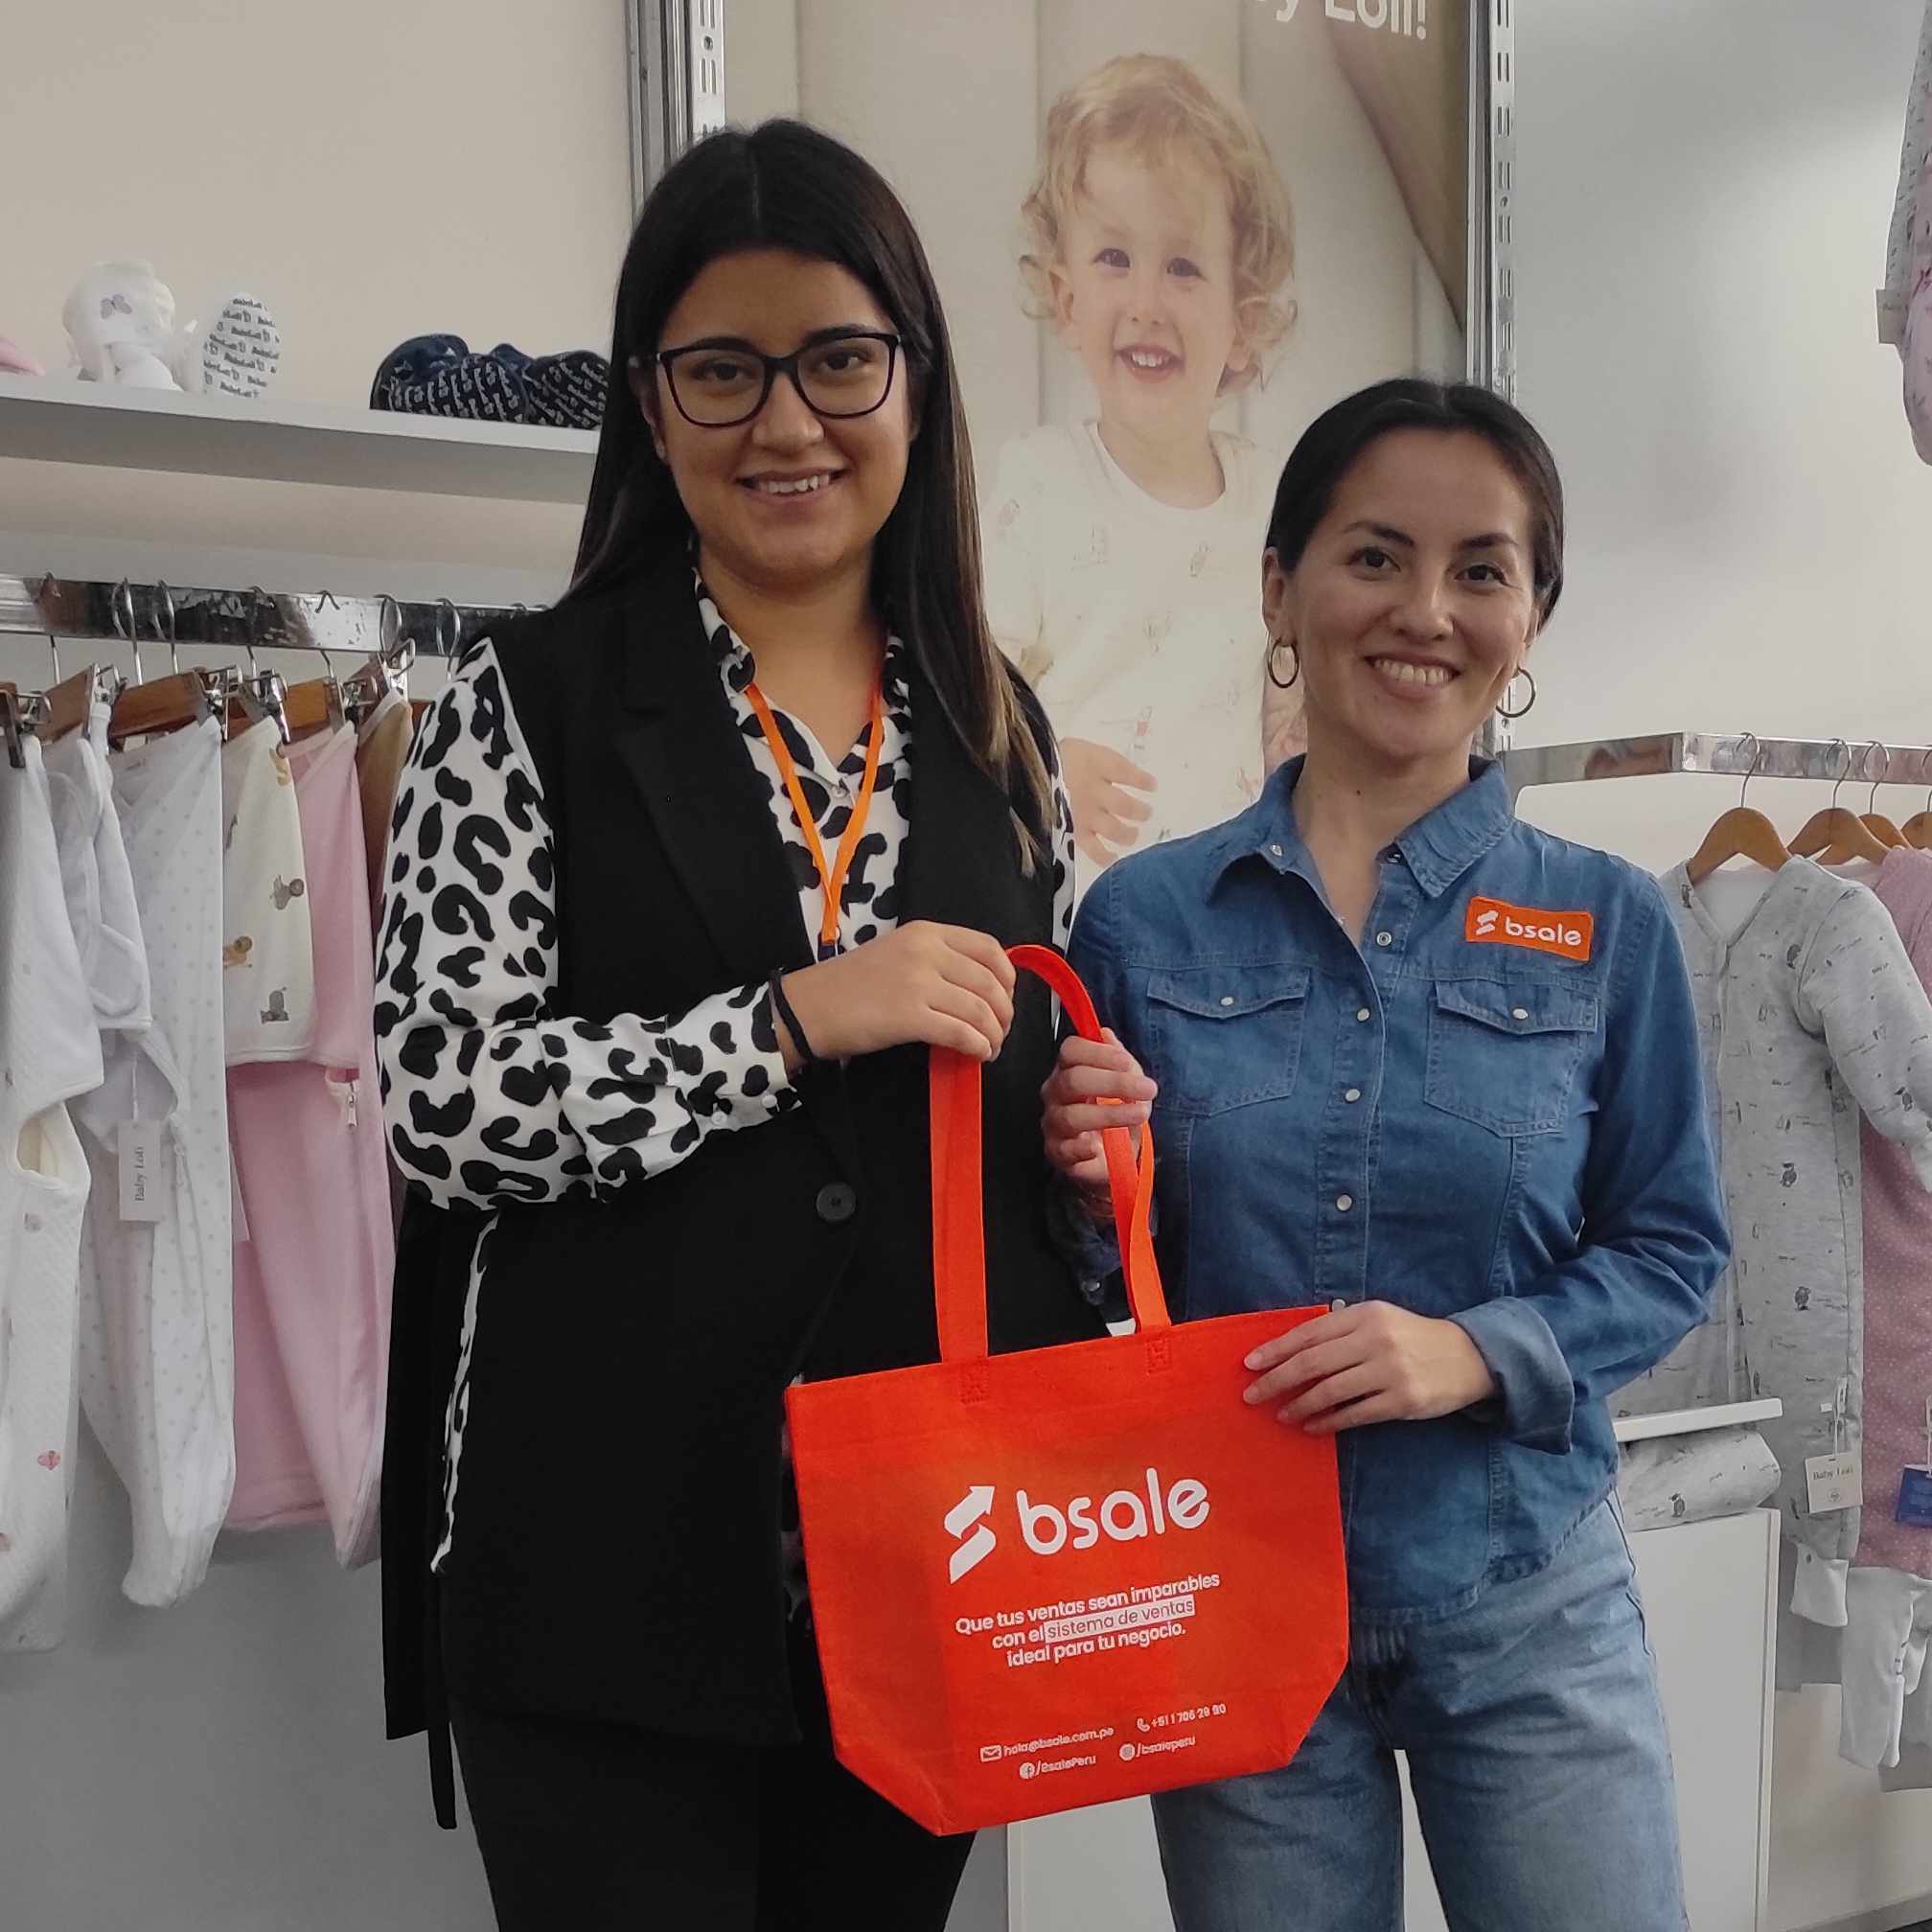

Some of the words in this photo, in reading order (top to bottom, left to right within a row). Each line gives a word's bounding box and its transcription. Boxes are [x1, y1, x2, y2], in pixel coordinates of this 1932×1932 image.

[1505, 915, 1582, 946] bsale
[1016, 1467, 1210, 1555] bsale
[954, 1617, 994, 1636] Que
[997, 1610, 1024, 1627] tus
[1026, 1599, 1086, 1622] ventas
[1088, 1592, 1128, 1612] sean
[1130, 1573, 1221, 1603] imparables
[992, 1632, 1026, 1649] con
[1028, 1624, 1045, 1643] el
[1047, 1616, 1115, 1640] sistema
[1117, 1607, 1138, 1626] de
[1141, 1598, 1194, 1621] ventas
[1007, 1644, 1050, 1668] ideal
[1053, 1642, 1095, 1664] para
[1097, 1635, 1116, 1651] tu
[1117, 1622, 1187, 1648] negocio.
